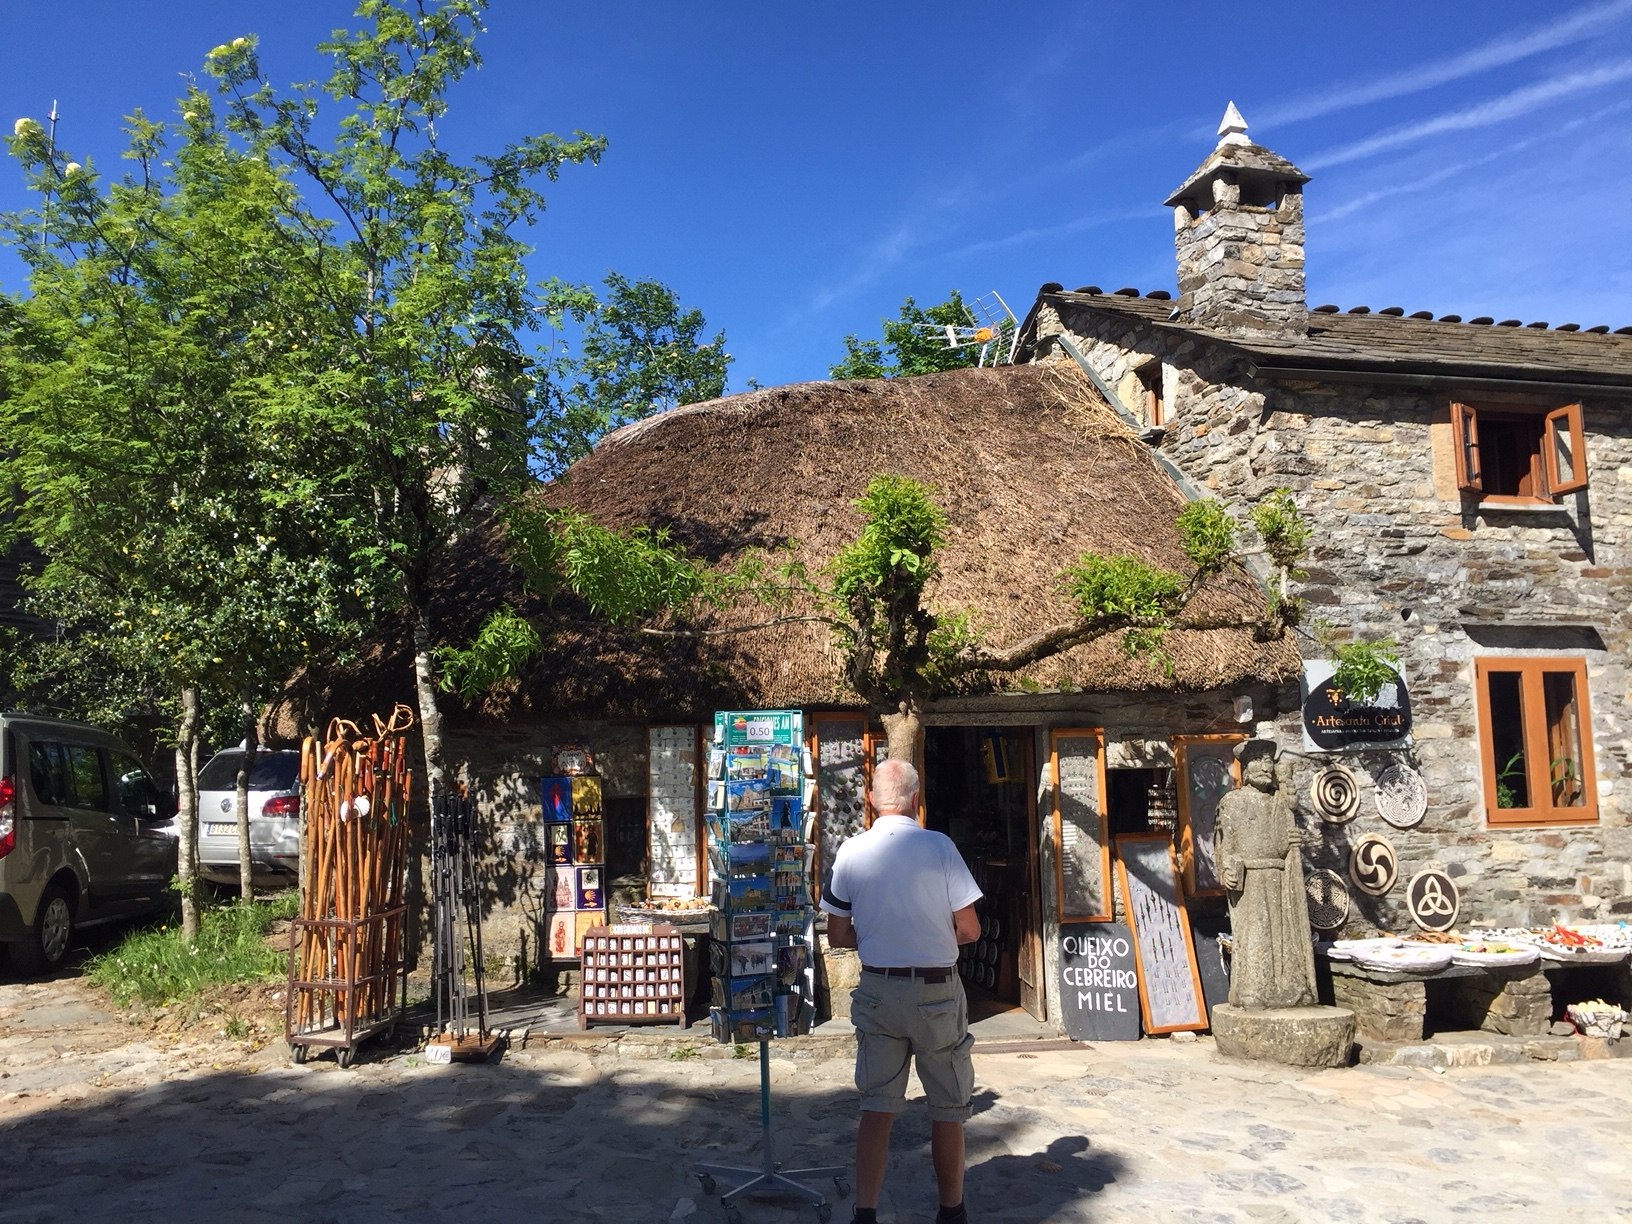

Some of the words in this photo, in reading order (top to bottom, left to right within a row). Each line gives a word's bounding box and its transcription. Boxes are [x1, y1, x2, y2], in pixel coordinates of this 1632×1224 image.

[749, 727, 770, 736] 0.50
[1063, 936, 1129, 957] QUEIXO
[1088, 955, 1110, 969] DO
[1063, 967, 1137, 989] CEBREIRO
[1078, 991, 1127, 1012] MIEL
